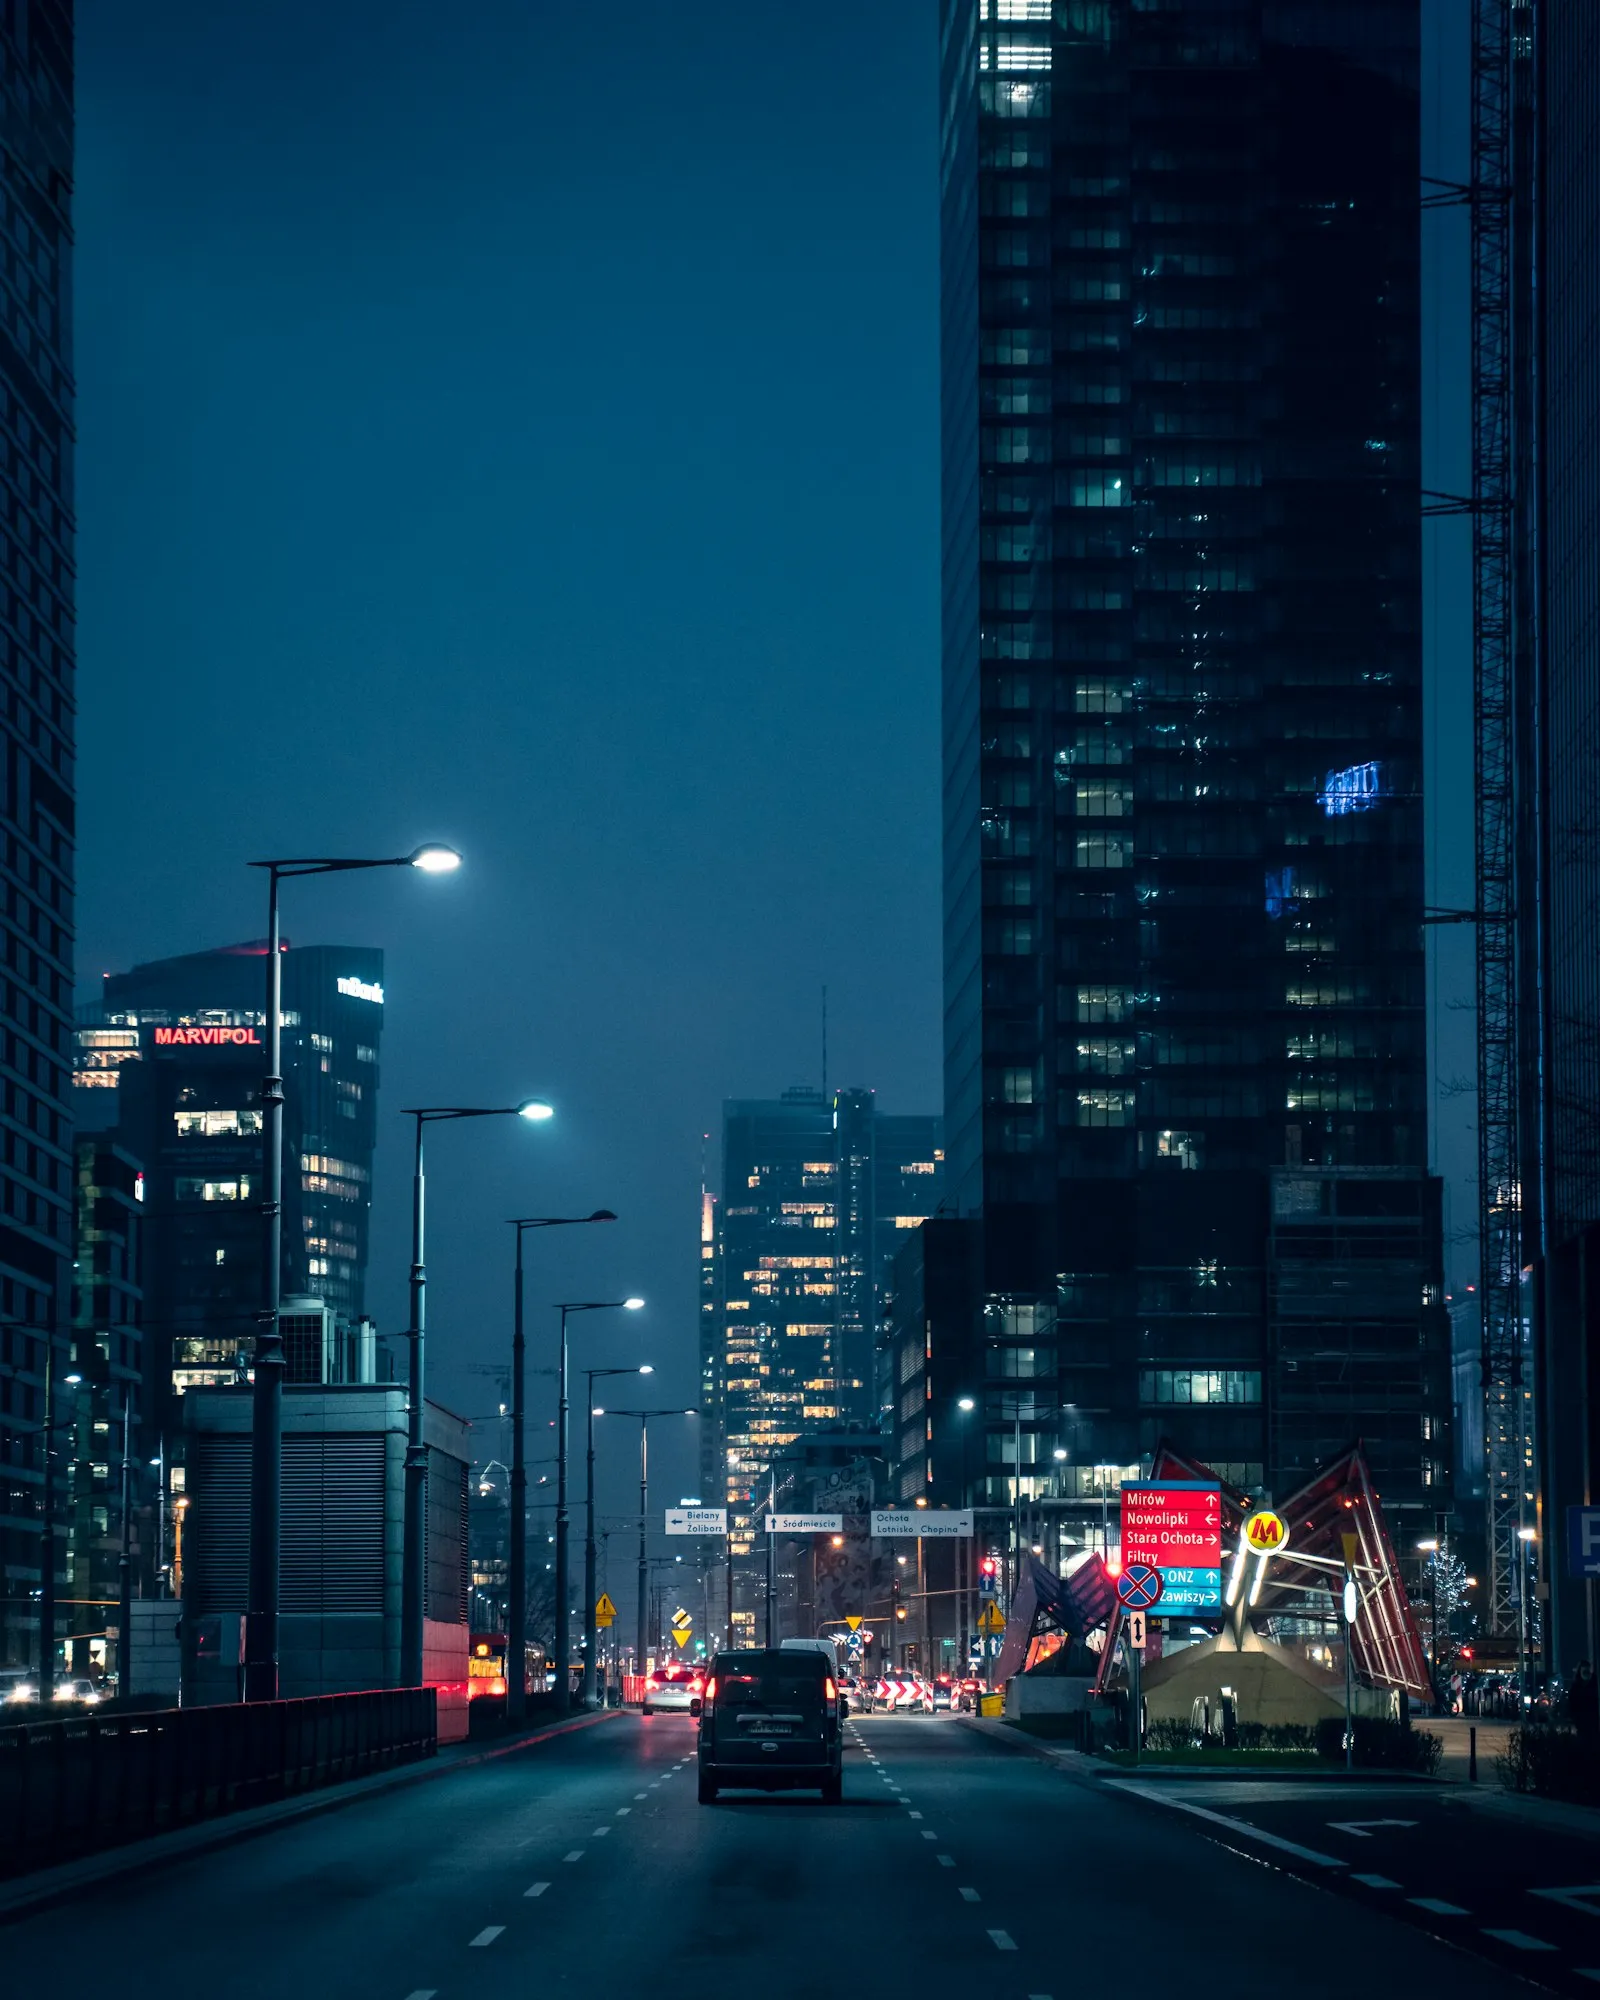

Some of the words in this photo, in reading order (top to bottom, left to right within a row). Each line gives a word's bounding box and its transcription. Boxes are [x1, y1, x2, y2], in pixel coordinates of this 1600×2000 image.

[155, 1028, 261, 1044] MARVIPOL
[1127, 1493, 1165, 1505] Mirów
[687, 1511, 720, 1521] Bielany
[876, 1513, 909, 1522] Ochota
[1127, 1512, 1189, 1528] Nowolipki
[687, 1522, 723, 1533] Żoliborz
[783, 1518, 836, 1528] Śródmieście
[877, 1525, 914, 1533] Lotnisko
[920, 1525, 958, 1535] Chopina
[1127, 1531, 1158, 1544] Stara
[1160, 1531, 1203, 1544] Ochota
[1127, 1550, 1159, 1567] Filtry
[1168, 1570, 1194, 1583] ONZ
[1160, 1589, 1206, 1606] Zawiszy
